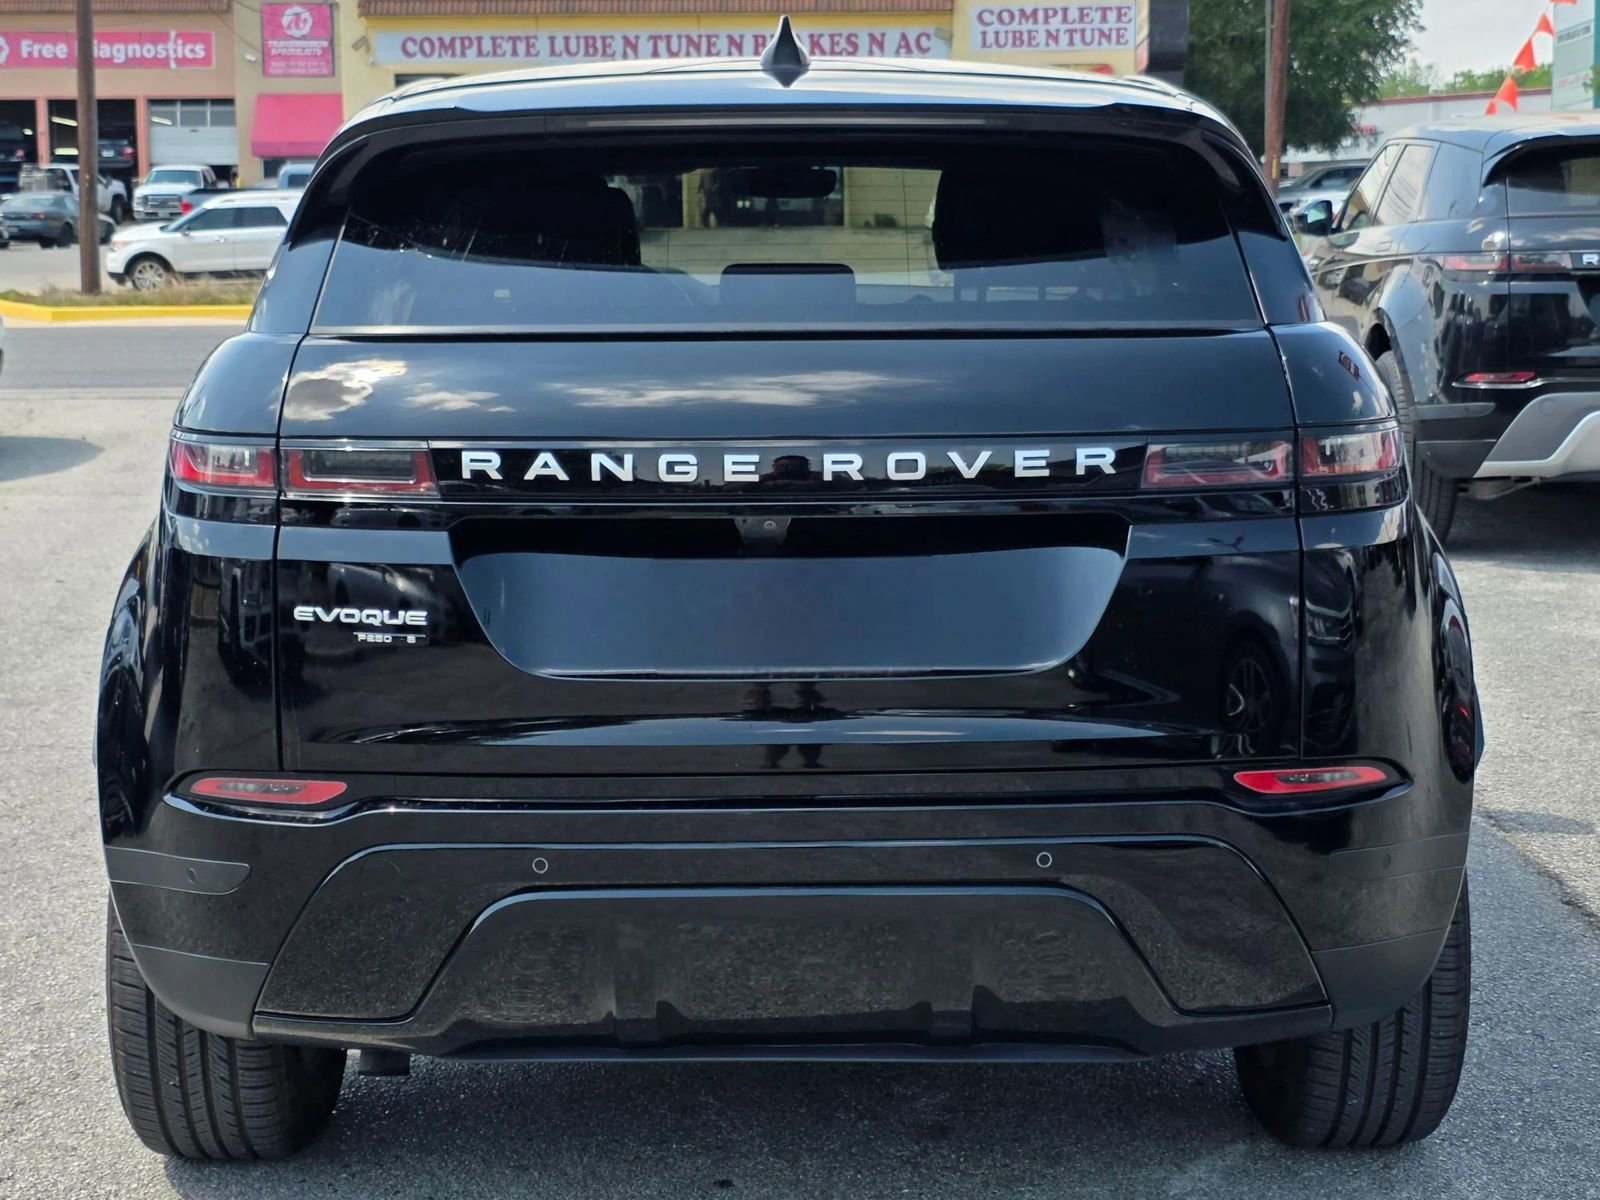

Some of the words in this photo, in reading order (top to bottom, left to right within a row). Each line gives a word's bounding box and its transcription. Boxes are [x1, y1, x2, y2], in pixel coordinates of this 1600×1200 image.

[976, 6, 1132, 27] COMPLETE
[20, 38, 69, 59] Free
[75, 37, 206, 63] iagnostics
[401, 35, 541, 59] COMPLETE
[548, 35, 617, 58] LUBE
[621, 35, 641, 59] N
[647, 34, 721, 58] TUNE
[727, 34, 745, 57] N
[752, 33, 859, 57] BKES
[867, 33, 886, 56] N
[894, 32, 932, 55] AC
[980, 29, 1040, 49] LUBE
[1045, 29, 1060, 48] N
[1064, 27, 1129, 47] TUNE
[460, 450, 760, 483] RANGE
[823, 447, 1117, 481] ROVER
[293, 605, 428, 626] EVOQUE
